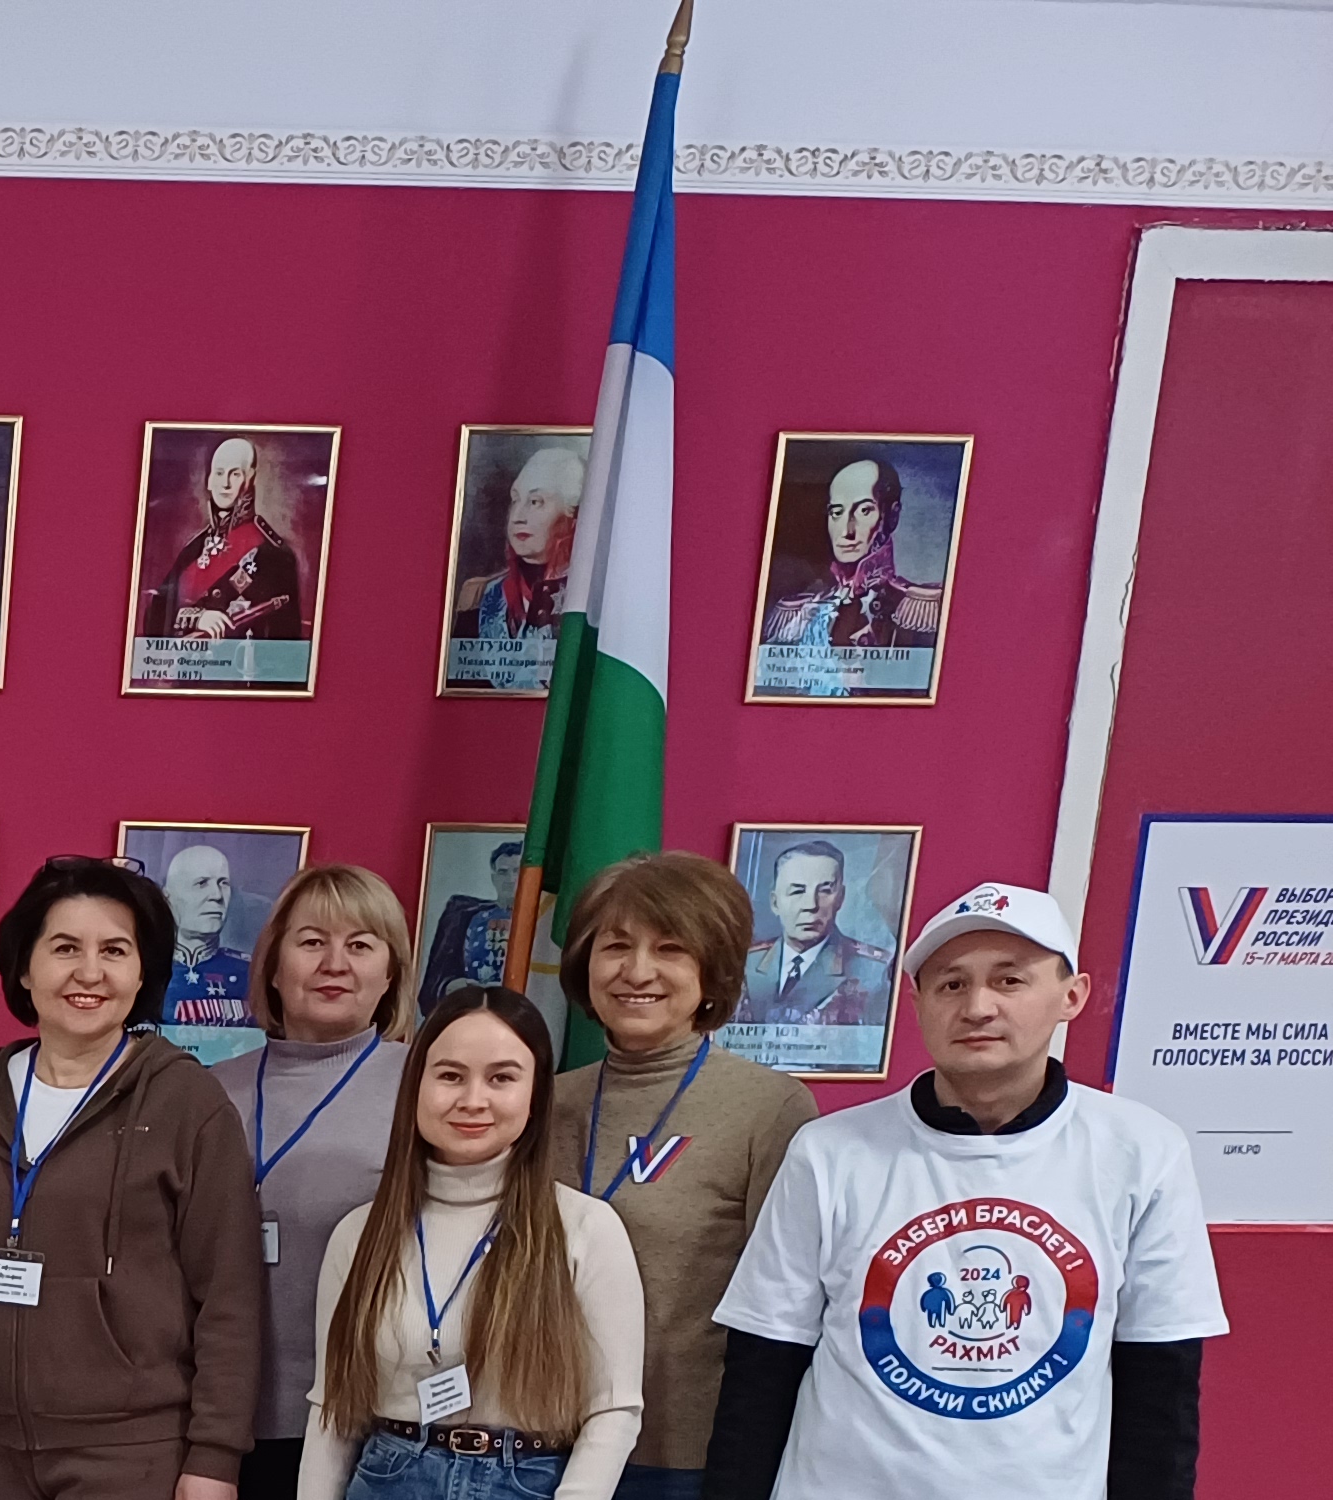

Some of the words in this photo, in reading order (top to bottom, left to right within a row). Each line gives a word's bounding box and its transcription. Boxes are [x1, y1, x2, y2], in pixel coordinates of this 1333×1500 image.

[146, 639, 209, 651] УШАКОВ
[459, 640, 523, 652] КУТУЗОВ
[143, 656, 175, 667] Федор
[177, 656, 232, 667] Федорович
[457, 656, 496, 667] Михаил
[1274, 887, 1333, 904] ВЫБОР
[1251, 931, 1324, 947] РОССИИ
[1277, 951, 1321, 966] МАРТА
[1172, 1023, 1241, 1041] ВМЕСТЕ
[1245, 1023, 1278, 1040] МЫ
[1282, 1023, 1329, 1040] СИЛА
[1152, 1049, 1246, 1066] ГОЛОСУЕМ
[1249, 1049, 1272, 1066] ЗА
[1276, 1049, 1333, 1066] РОССИ
[883, 1208, 968, 1266] ЗАБЕРИ
[960, 1267, 1001, 1281] 2024
[929, 1334, 1021, 1362] РАХМАТ
[878, 1354, 964, 1413] ПОЛУЧИ
